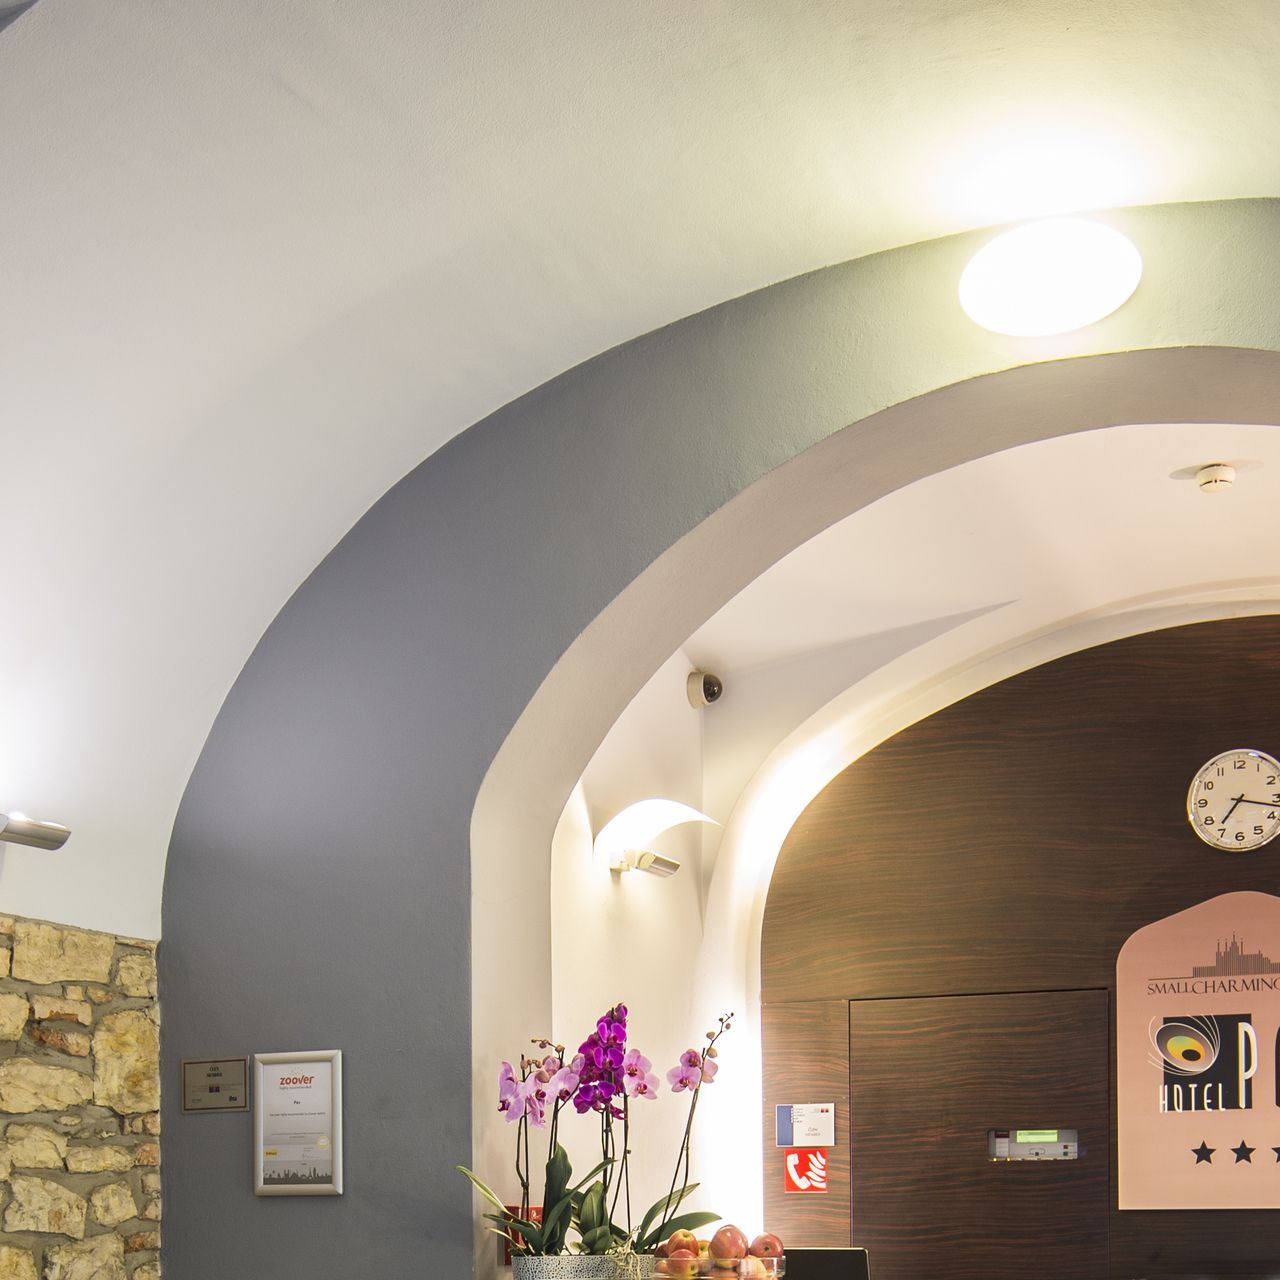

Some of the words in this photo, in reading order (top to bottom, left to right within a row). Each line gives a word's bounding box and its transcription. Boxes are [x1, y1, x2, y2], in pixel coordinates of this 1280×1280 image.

[1234, 760, 1246, 769] 12
[1217, 767, 1224, 776] 11
[1266, 776, 1276, 785] 2
[1204, 781, 1214, 790] 10
[1198, 799, 1208, 808] 9
[1267, 811, 1276, 820] 4
[1204, 816, 1214, 825] 8
[1217, 829, 1226, 838] 7
[1253, 826, 1264, 835] 5
[1235, 832, 1245, 841] 6
[279, 1075, 315, 1086] zoover
[1159, 1083, 1226, 1113] HOTEL
